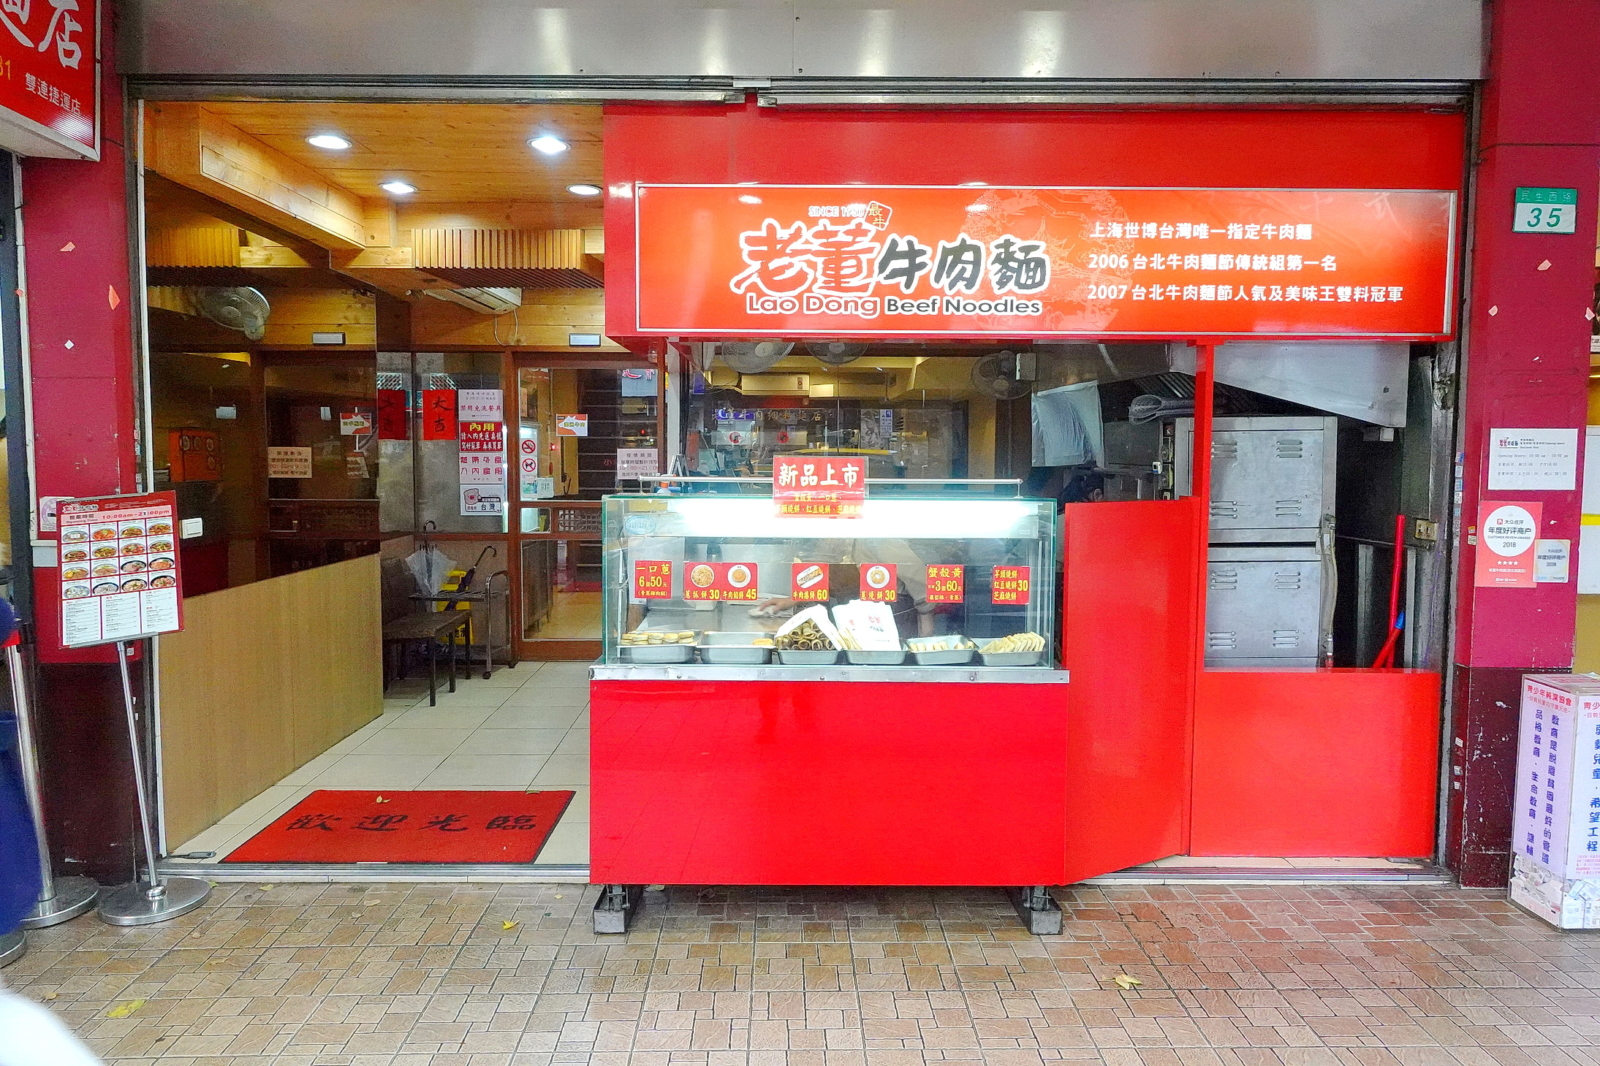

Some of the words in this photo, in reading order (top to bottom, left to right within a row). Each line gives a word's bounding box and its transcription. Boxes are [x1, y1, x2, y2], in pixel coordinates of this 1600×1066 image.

[25, 72, 81, 115] 雙連捷運店
[1527, 207, 1562, 228] 35
[1090, 223, 1312, 240] 上海世博台灣唯一指定牛肉麵
[731, 219, 1047, 296] 老董牛肉麵
[748, 294, 799, 314] Lao
[803, 294, 880, 318] Dong
[886, 297, 939, 314] Beef
[944, 297, 1041, 314] Noodles
[778, 463, 860, 488] 新品上市
[1488, 527, 1532, 535] 年度好评商户
[709, 589, 720, 599] 30
[746, 588, 757, 599] 45
[1017, 580, 1028, 591] 30
[816, 589, 828, 600] 60
[884, 589, 896, 600] 30
[286, 813, 537, 831] 歡迎光臨
